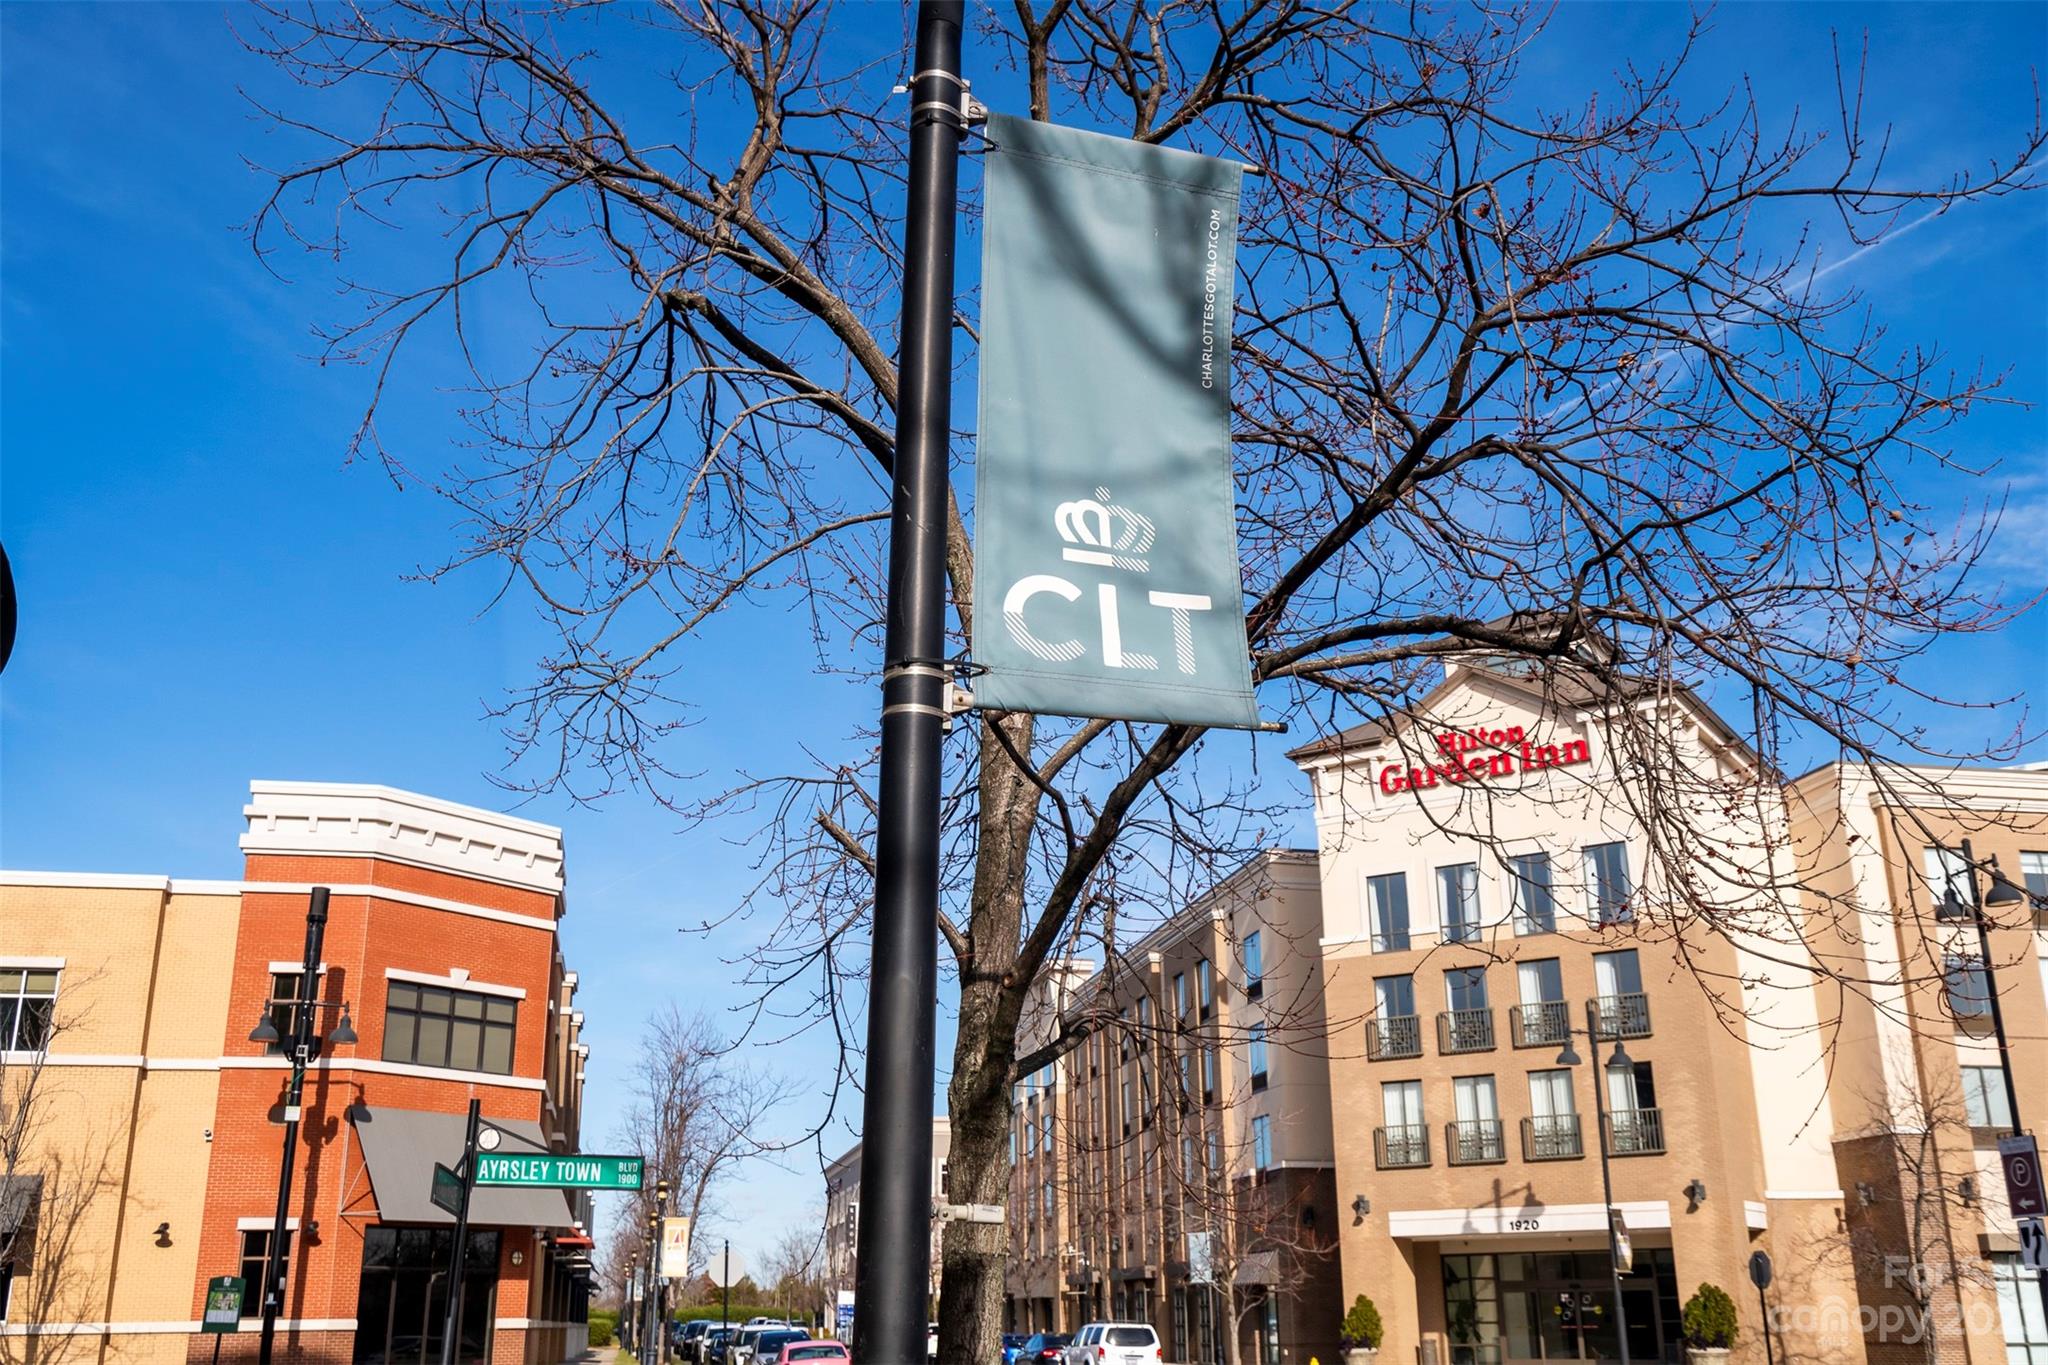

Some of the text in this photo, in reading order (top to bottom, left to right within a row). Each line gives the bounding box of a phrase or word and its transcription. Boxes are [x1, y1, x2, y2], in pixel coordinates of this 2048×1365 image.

[1201, 209, 1221, 389] CHARLOTTESGOTALOT.COM
[1003, 574, 1212, 675] CLT
[1437, 725, 1524, 755] Hilton
[1380, 738, 1591, 795] Garden Inn
[478, 1159, 602, 1182] AYRSLEY TOWN
[618, 1162, 638, 1173] BLVD
[618, 1173, 637, 1184] 1900
[2015, 1163, 2026, 1181] P
[1509, 1219, 1540, 1231] 1920
